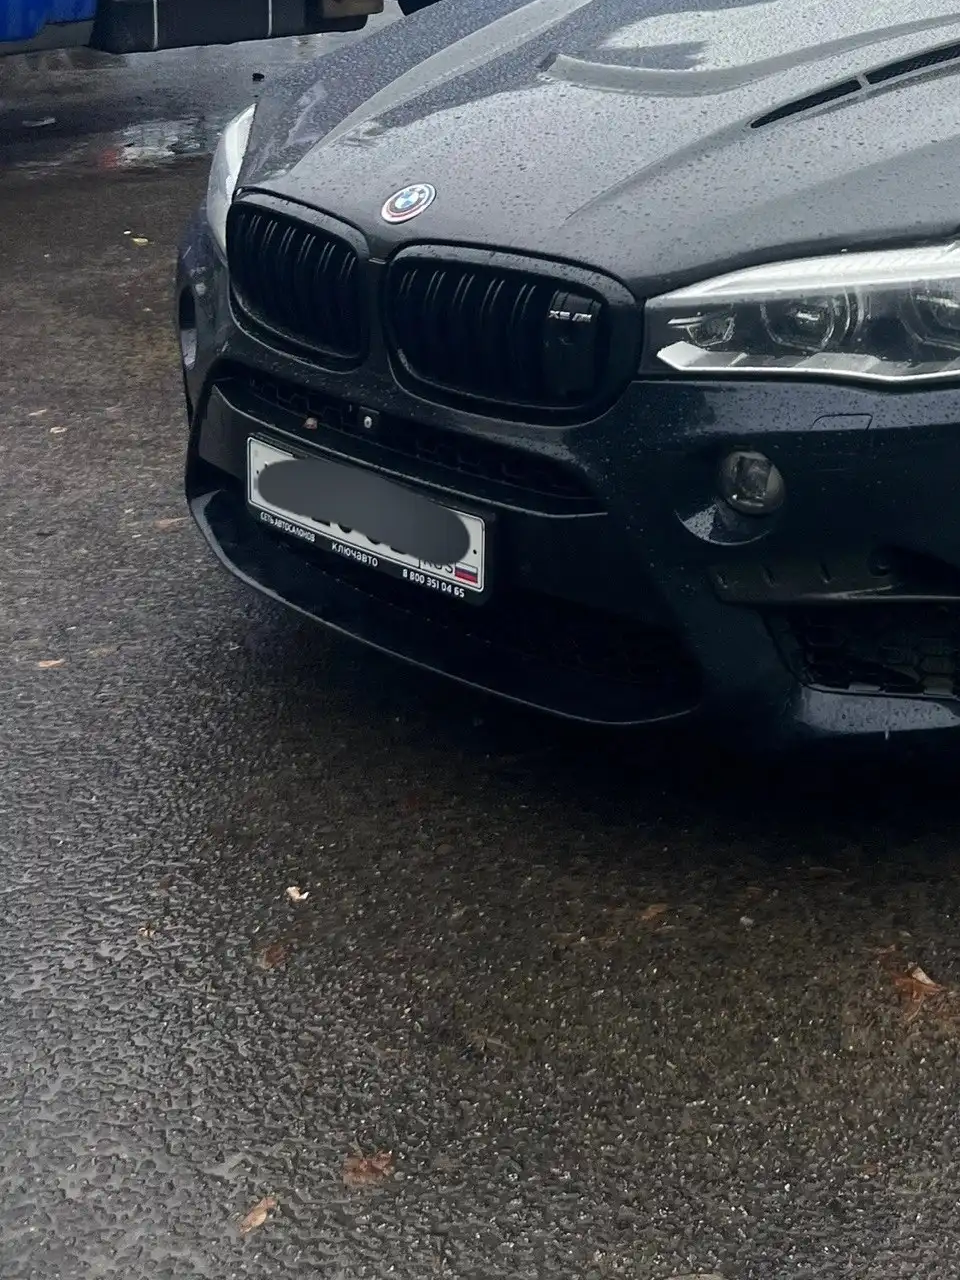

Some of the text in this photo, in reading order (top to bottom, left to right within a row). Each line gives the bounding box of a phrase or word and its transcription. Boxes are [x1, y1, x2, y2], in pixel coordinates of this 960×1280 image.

[260, 511, 275, 524] СЕТЬ
[274, 518, 316, 542] АВТОСАЛОНОВ
[409, 571, 425, 583] 800
[426, 577, 440, 589] 351
[441, 582, 452, 593] 04
[453, 586, 465, 598] 65
